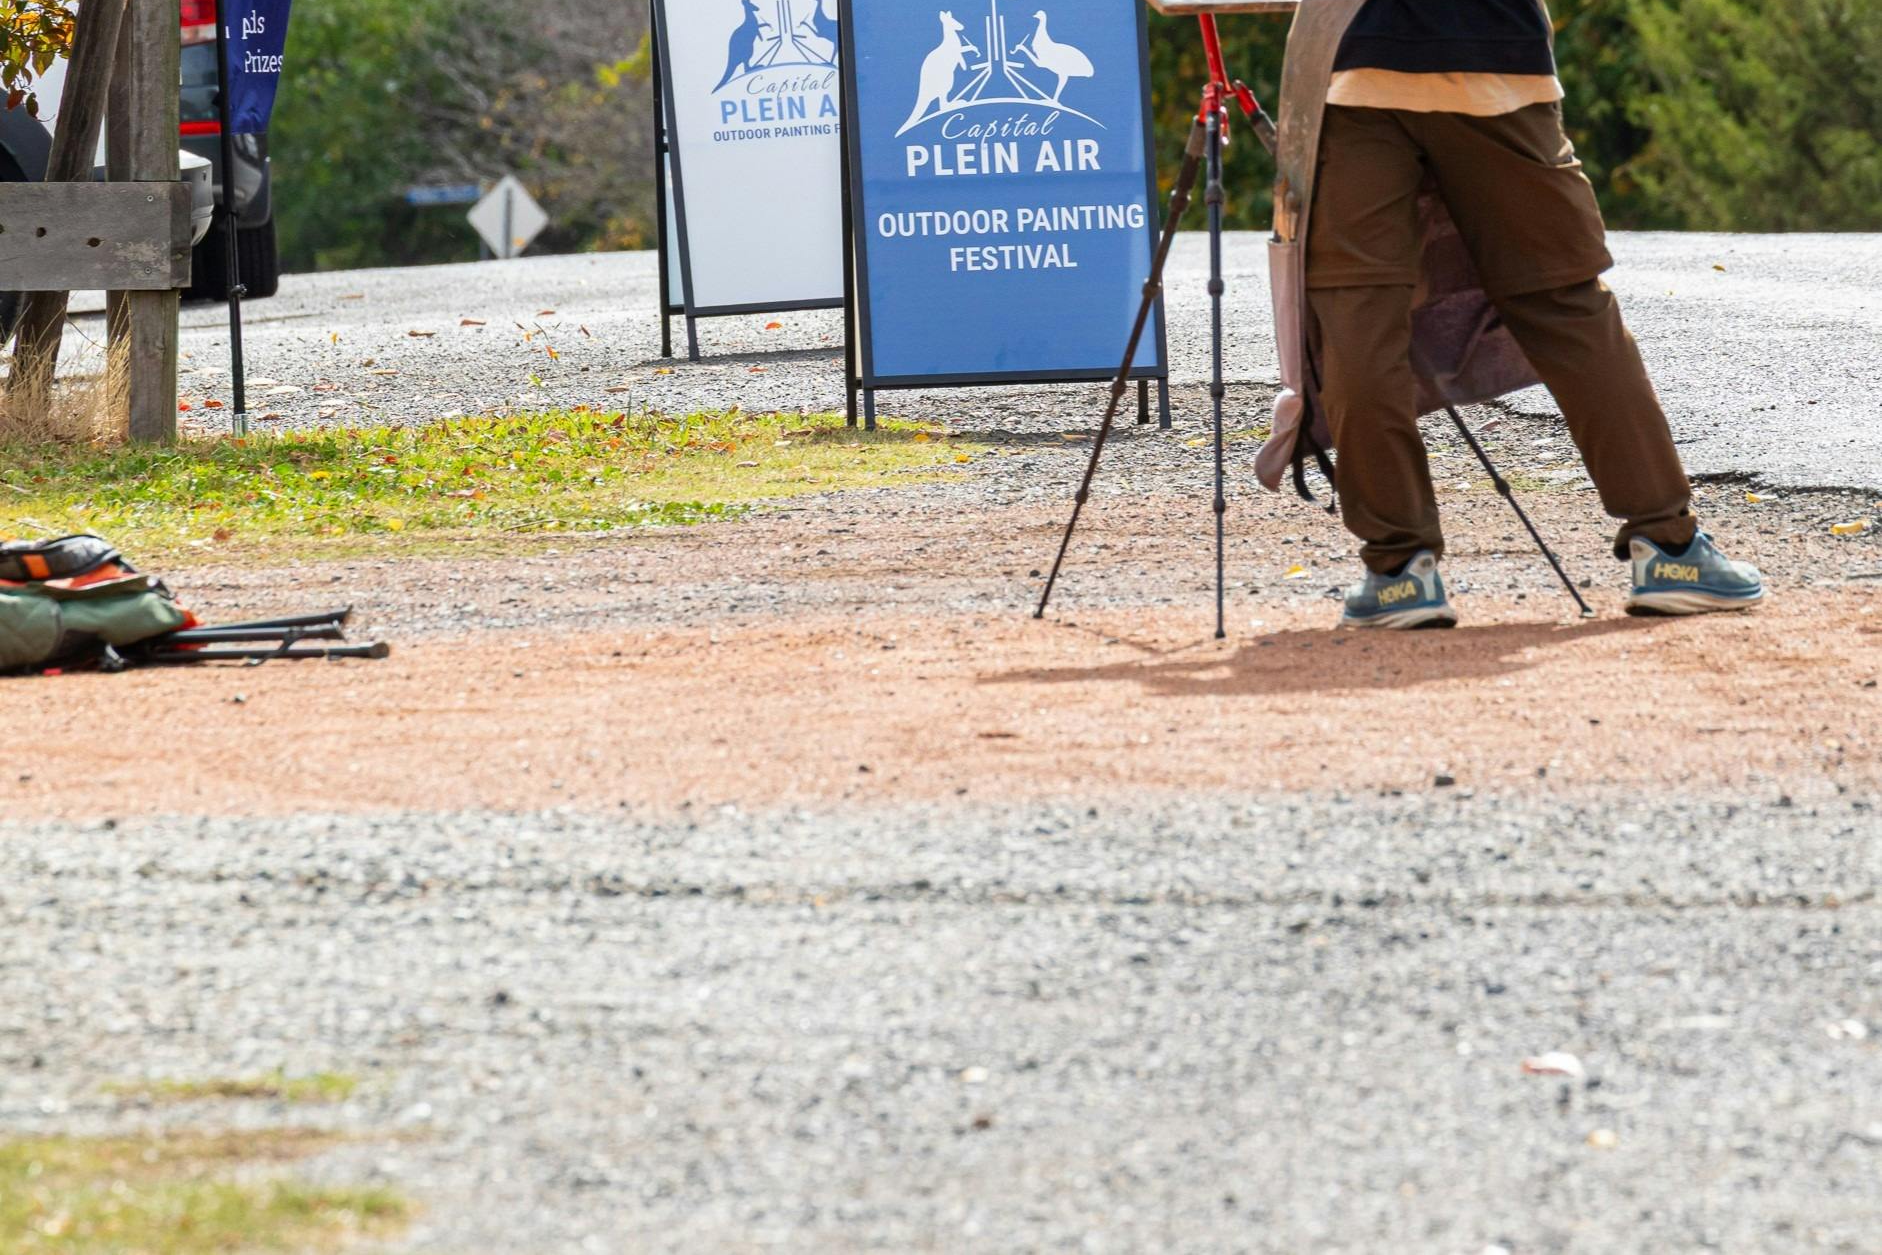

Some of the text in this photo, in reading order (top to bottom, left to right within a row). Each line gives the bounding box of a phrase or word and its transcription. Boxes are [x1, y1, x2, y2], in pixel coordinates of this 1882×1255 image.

[746, 70, 837, 98] Capital
[720, 95, 807, 124] PLEIN
[713, 127, 772, 142] OUTDOOR
[774, 123, 832, 138] PAINTING
[941, 111, 1060, 148] Capital
[906, 139, 1101, 177] PLEIN AIR
[878, 203, 1145, 238] OUTDOOR PAINTING
[950, 244, 1078, 272] FESTIVAL
[1653, 562, 1699, 583] HOKA
[1377, 579, 1417, 606] HOKA
